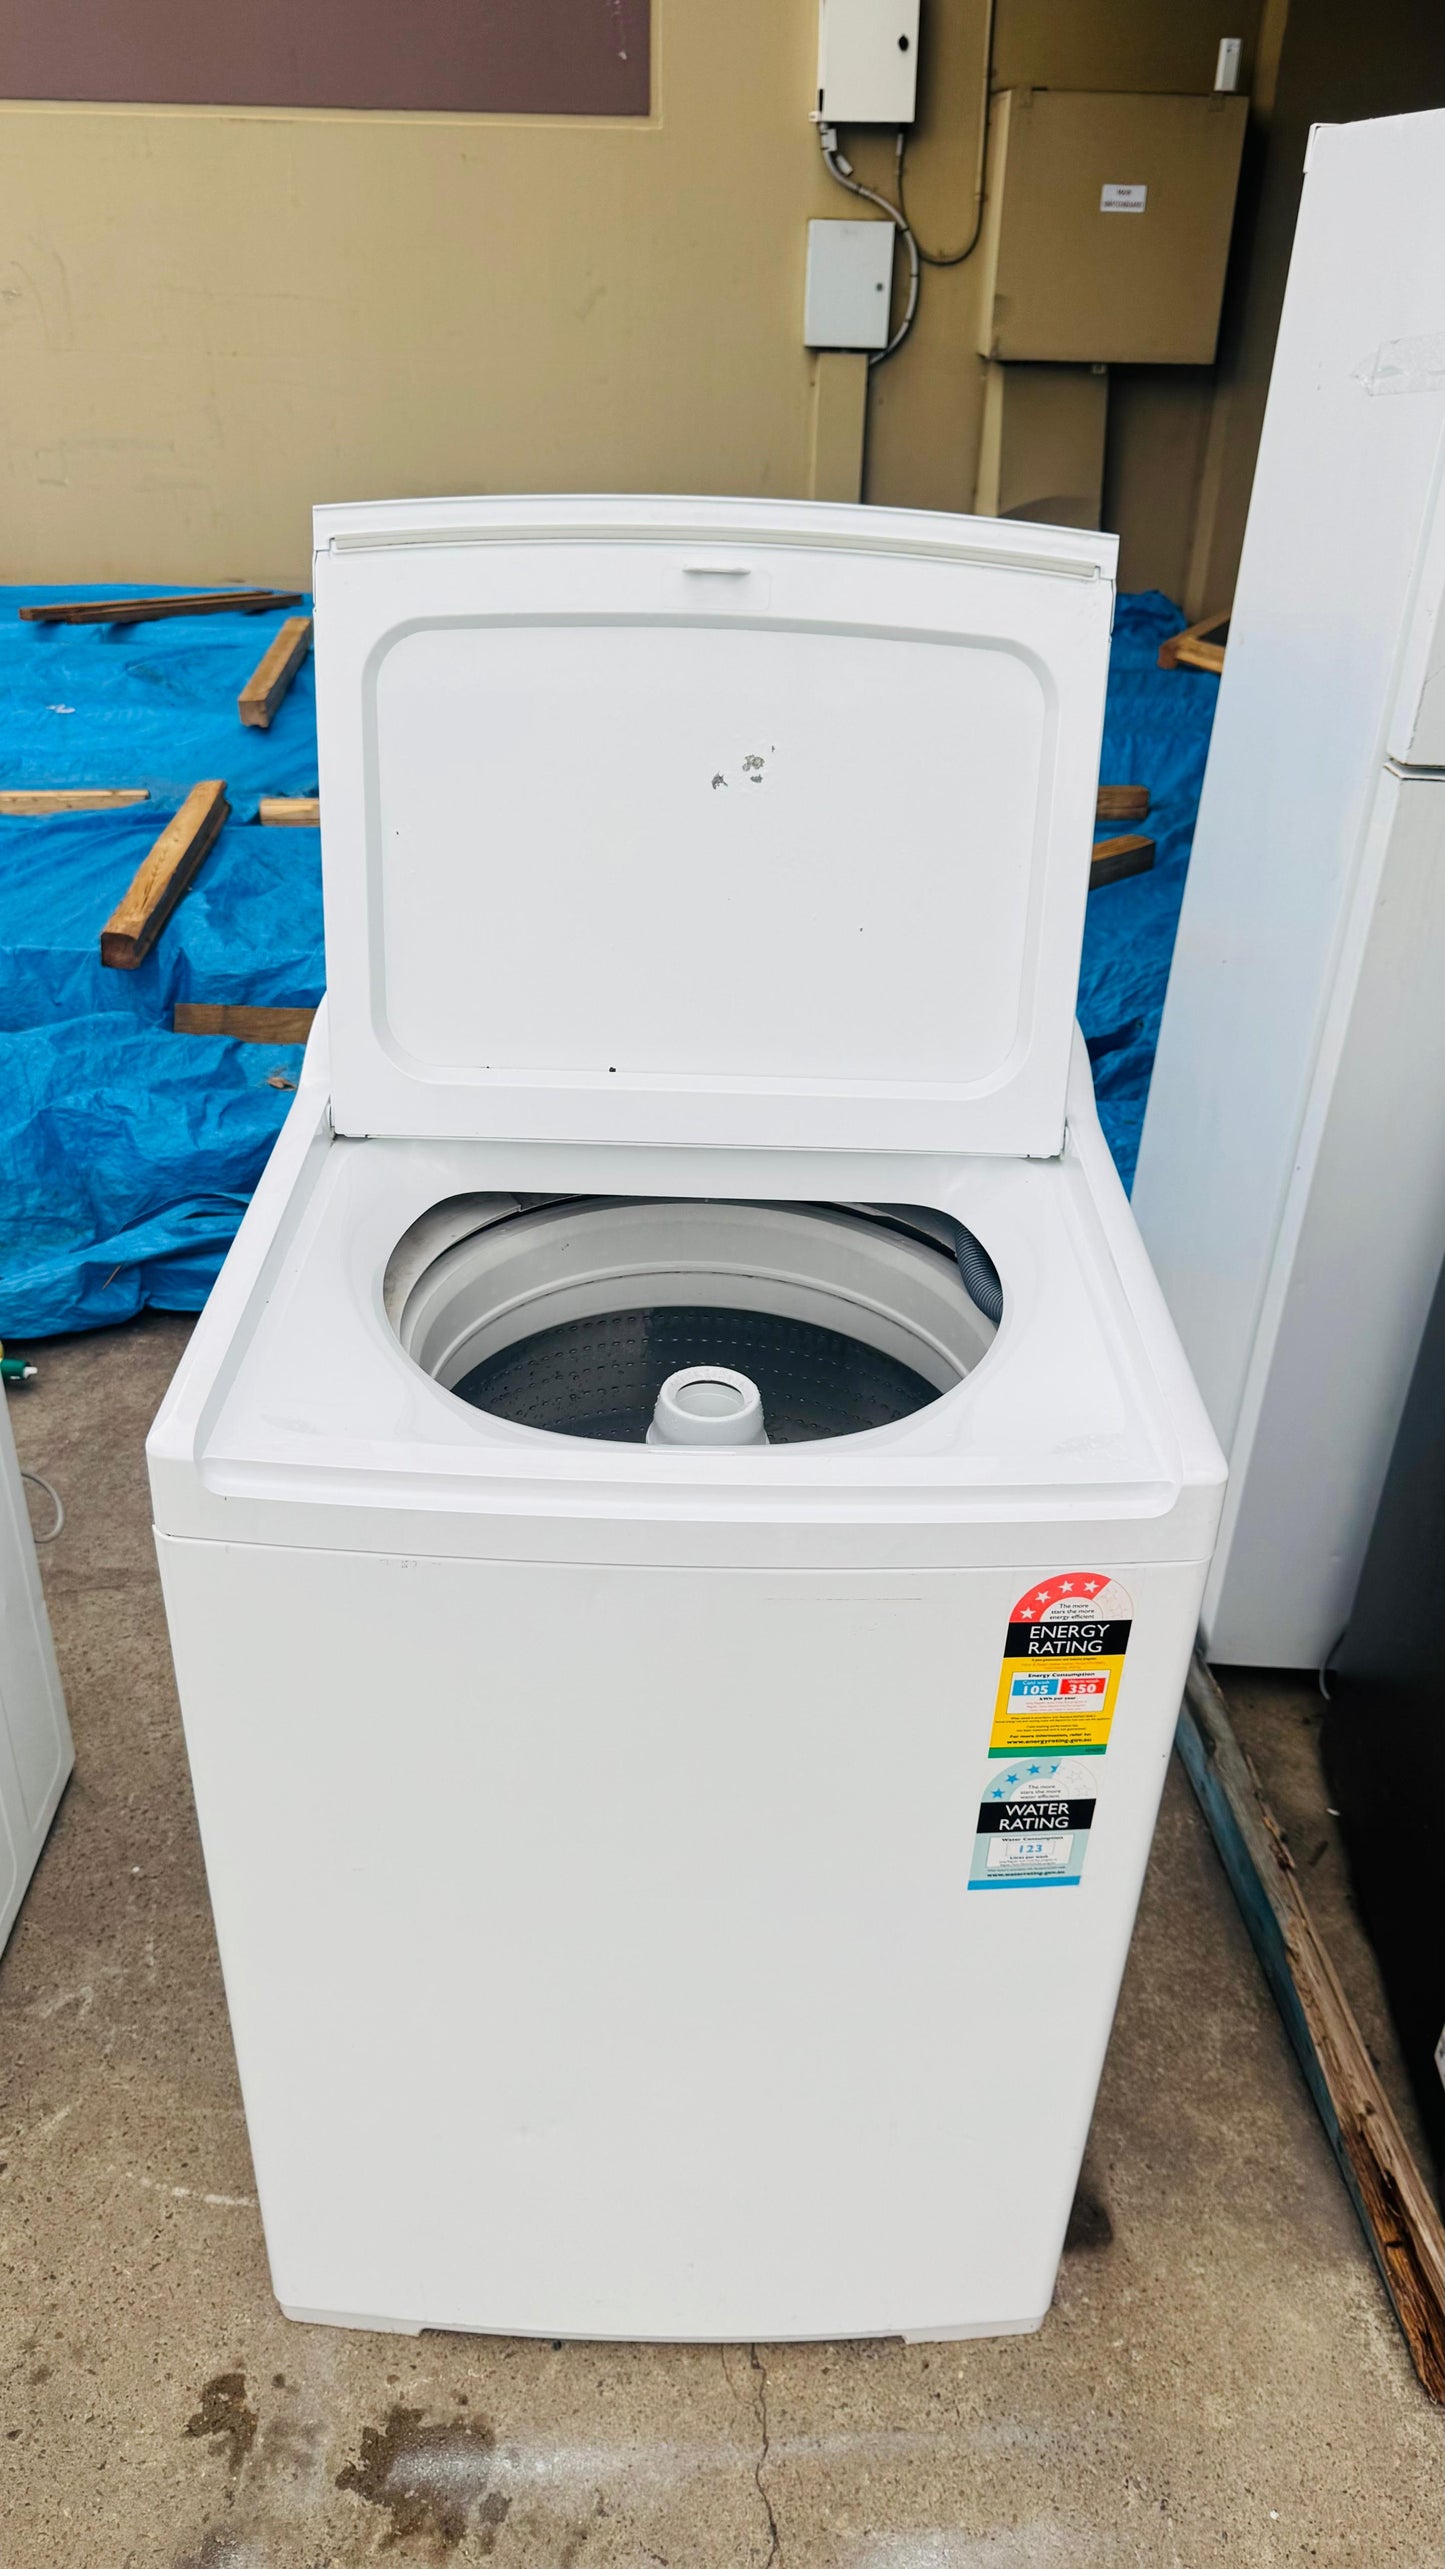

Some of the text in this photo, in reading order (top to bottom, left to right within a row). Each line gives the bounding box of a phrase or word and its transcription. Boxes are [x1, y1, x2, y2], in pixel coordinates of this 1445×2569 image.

[1029, 1624, 1110, 1639] ENERGY
[1028, 1640, 1103, 1655] RATING
[1023, 1685, 1049, 1695] 105
[1068, 1684, 1097, 1694] 350
[1005, 1802, 1070, 1816] WATER
[999, 1816, 1069, 1830] RATING
[1019, 1844, 1043, 1854] 123
